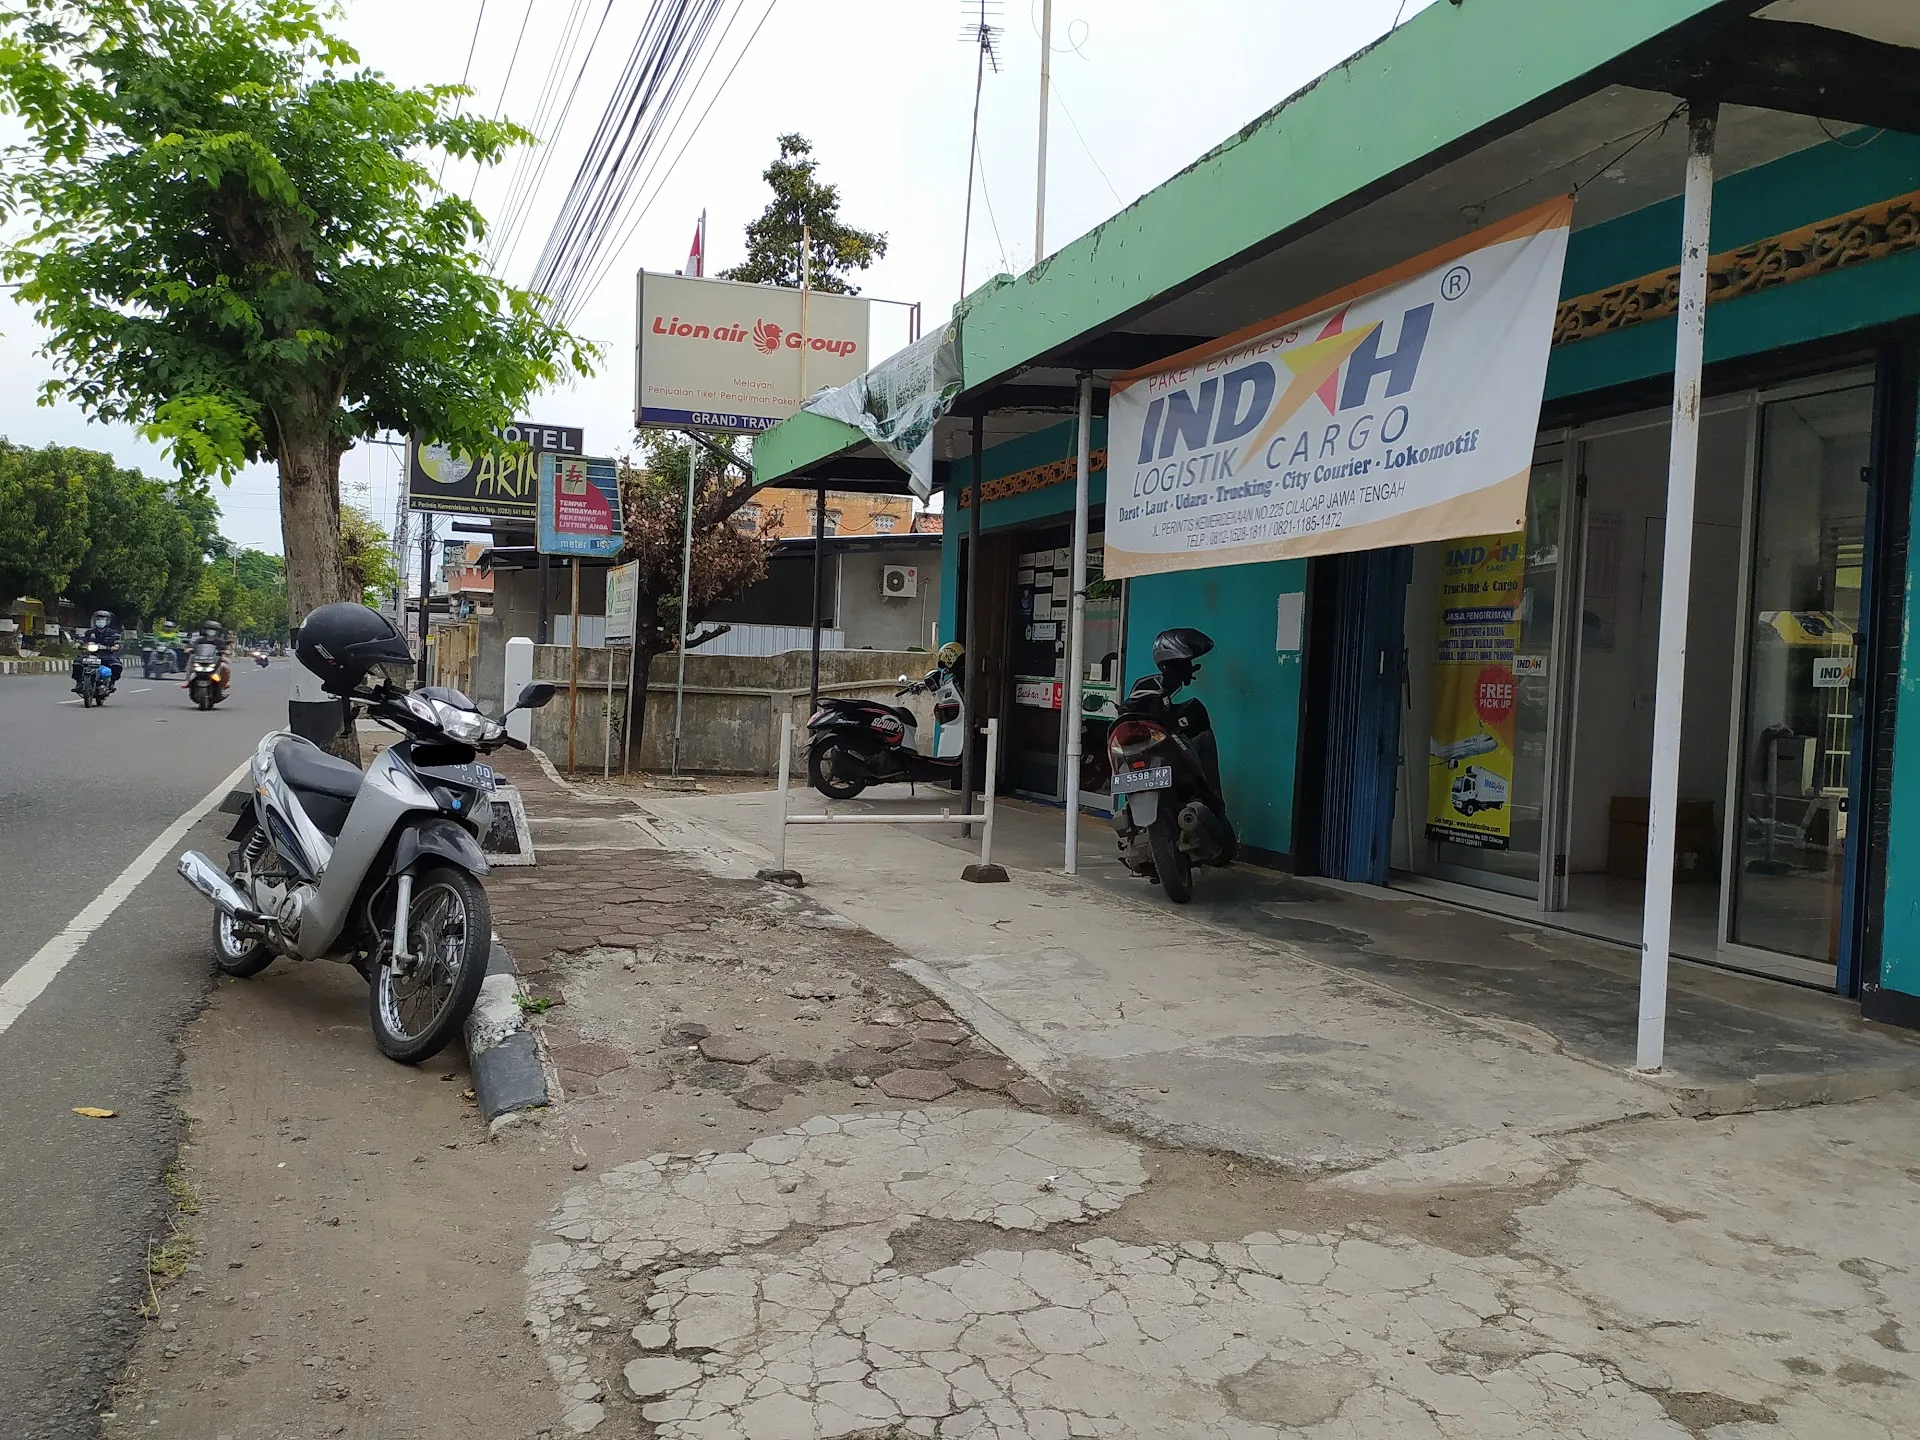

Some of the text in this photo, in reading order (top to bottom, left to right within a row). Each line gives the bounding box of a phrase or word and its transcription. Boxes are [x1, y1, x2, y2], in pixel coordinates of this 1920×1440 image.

[652, 316, 857, 358] Lion air Group
[1206, 326, 1302, 373] EXPRESS
[733, 378, 776, 390] Melayani
[1137, 302, 1435, 465] INDAH
[648, 385, 694, 398] Penjualan
[720, 391, 770, 404] Pengiriman
[773, 397, 796, 406] Paket
[691, 412, 738, 427] GRAND
[1133, 404, 1409, 499] LOGISTIK CARGO
[1118, 428, 1481, 523] Darat Laut Udara Trucking City Courier Lokomotif
[559, 499, 587, 508] TEMPAT
[1286, 494, 1325, 516] CILACAP
[1326, 489, 1356, 508] JAWA
[1359, 480, 1408, 503] TENGAH
[559, 507, 607, 517] PEMBAYARAN
[559, 514, 596, 523] REKENING
[559, 521, 608, 531] LISTRIK ANDA
[1273, 511, 1343, 537] 0821-1185-1472
[560, 539, 588, 549] meter
[1443, 581, 1480, 595] Trucking
[1492, 579, 1519, 592] Cargo
[1446, 610, 1513, 621] JASA PENGIRIMAN
[1516, 659, 1542, 669] INDAH
[1479, 683, 1513, 699] FREE
[1479, 699, 1511, 709] PICK UP
[1114, 768, 1168, 785] R 5598 KP
